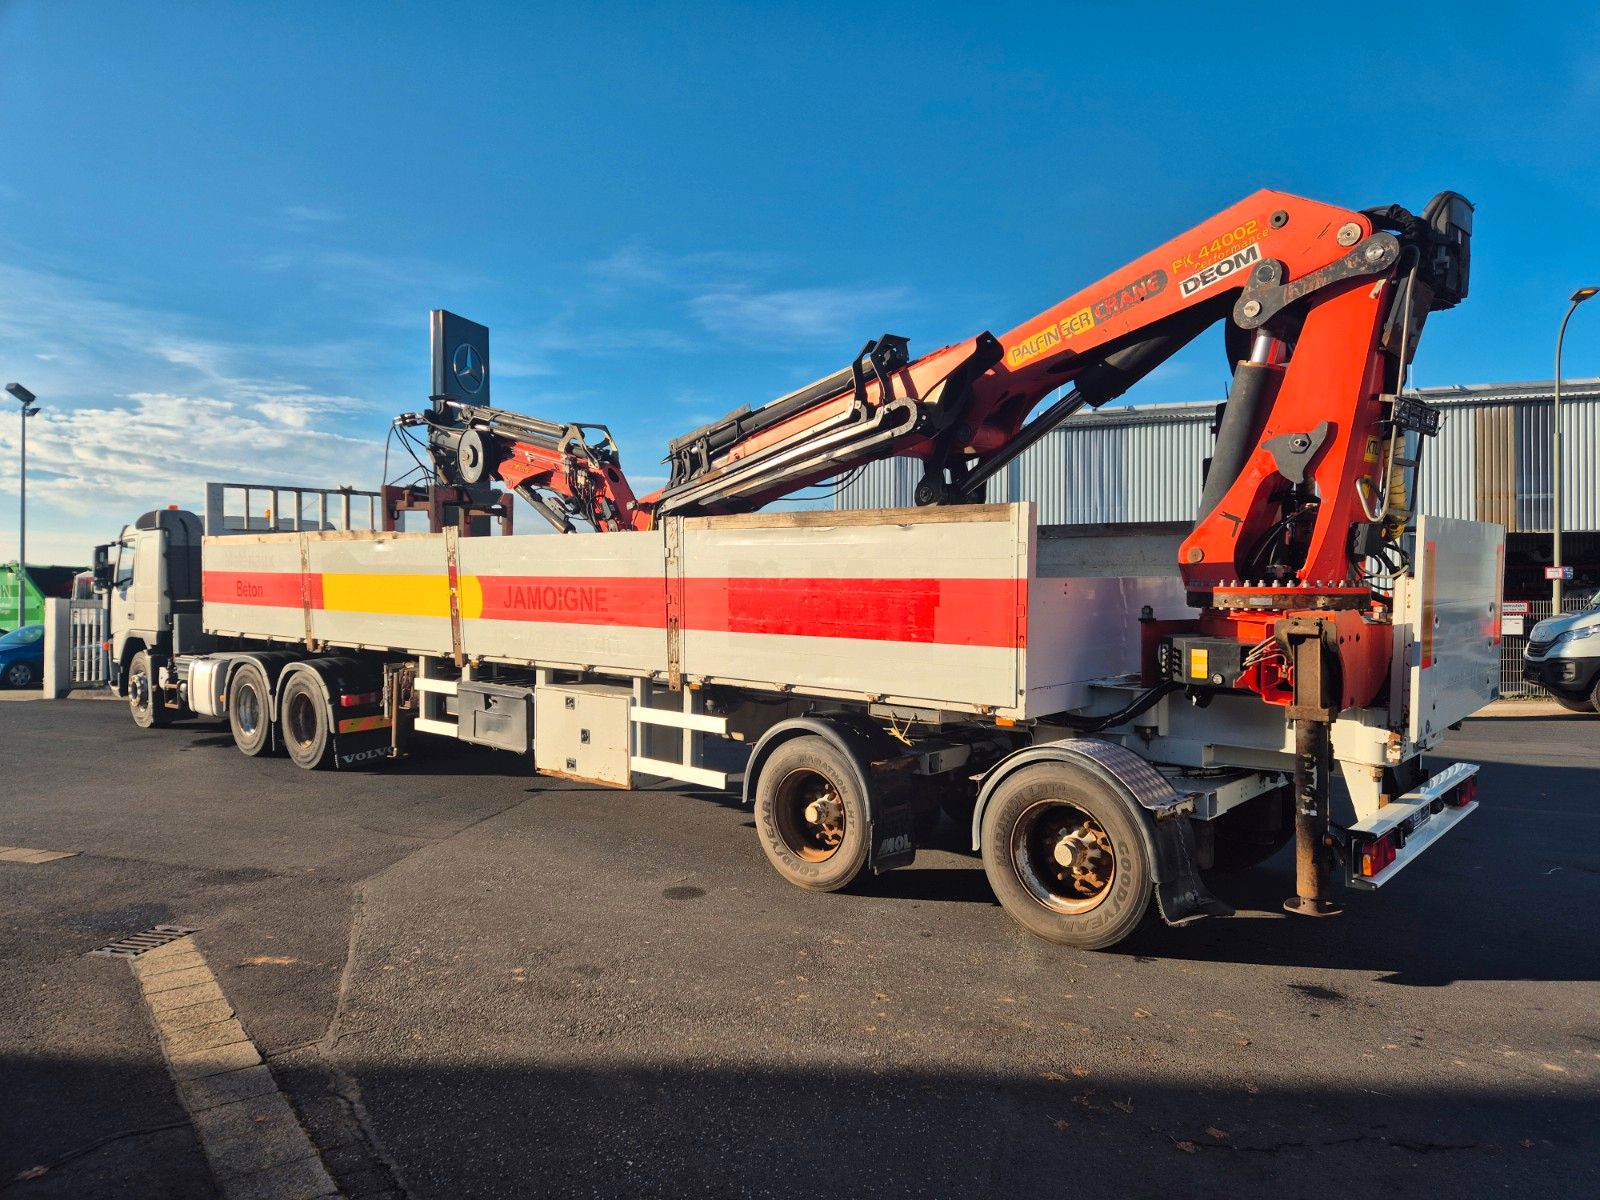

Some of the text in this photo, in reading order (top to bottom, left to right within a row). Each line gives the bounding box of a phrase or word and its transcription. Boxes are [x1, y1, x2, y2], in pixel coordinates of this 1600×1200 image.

[1171, 220, 1258, 274] PK 44002
[1182, 246, 1258, 294] DEOM
[1011, 312, 1091, 362] PALFINGER
[236, 580, 264, 598] Béton
[503, 586, 609, 613] JAMOIGNE
[799, 755, 848, 795] MARATHON
[762, 801, 820, 878] GOODYEAR
[1056, 840, 1132, 932] GOODYEAR
